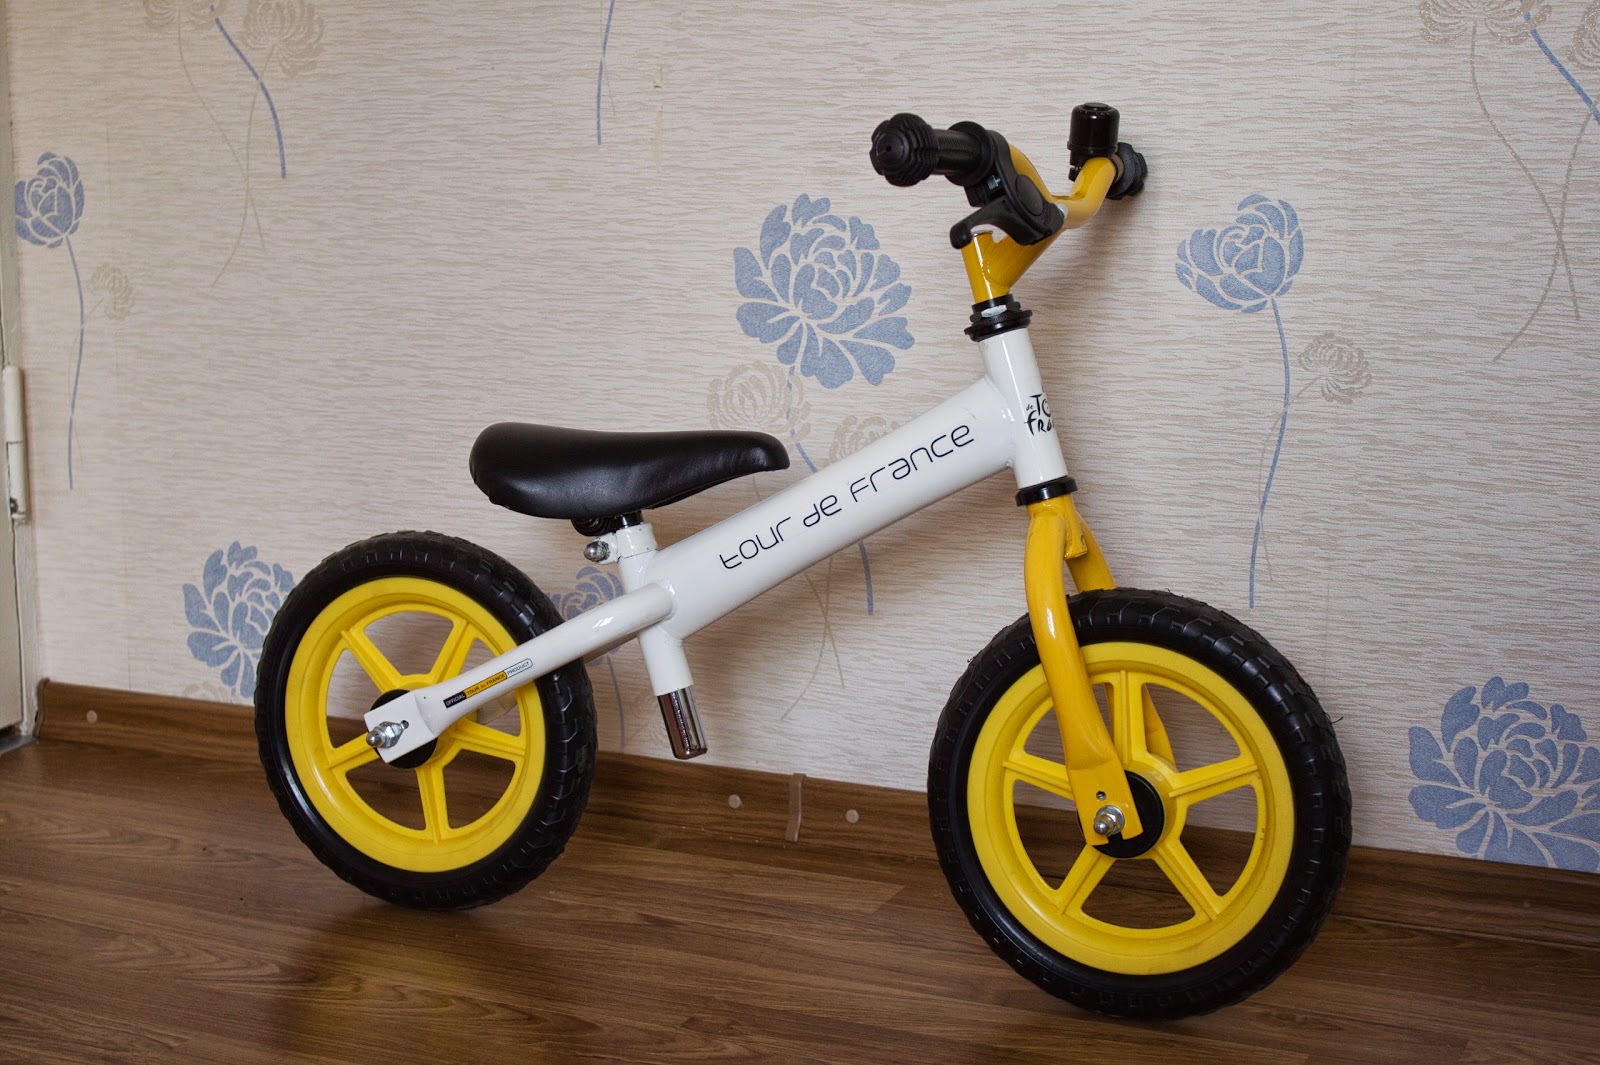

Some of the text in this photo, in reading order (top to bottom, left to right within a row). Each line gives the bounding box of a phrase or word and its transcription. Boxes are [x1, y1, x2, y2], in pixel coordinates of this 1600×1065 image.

[1024, 409, 1054, 436] FRA
[1029, 393, 1052, 418] TO
[719, 516, 791, 569] tour
[803, 495, 842, 527] de
[445, 693, 465, 706] OFFICIAL
[466, 685, 480, 695] TOUR
[486, 673, 505, 686] FRANCE
[506, 660, 531, 676] PRODUCT
